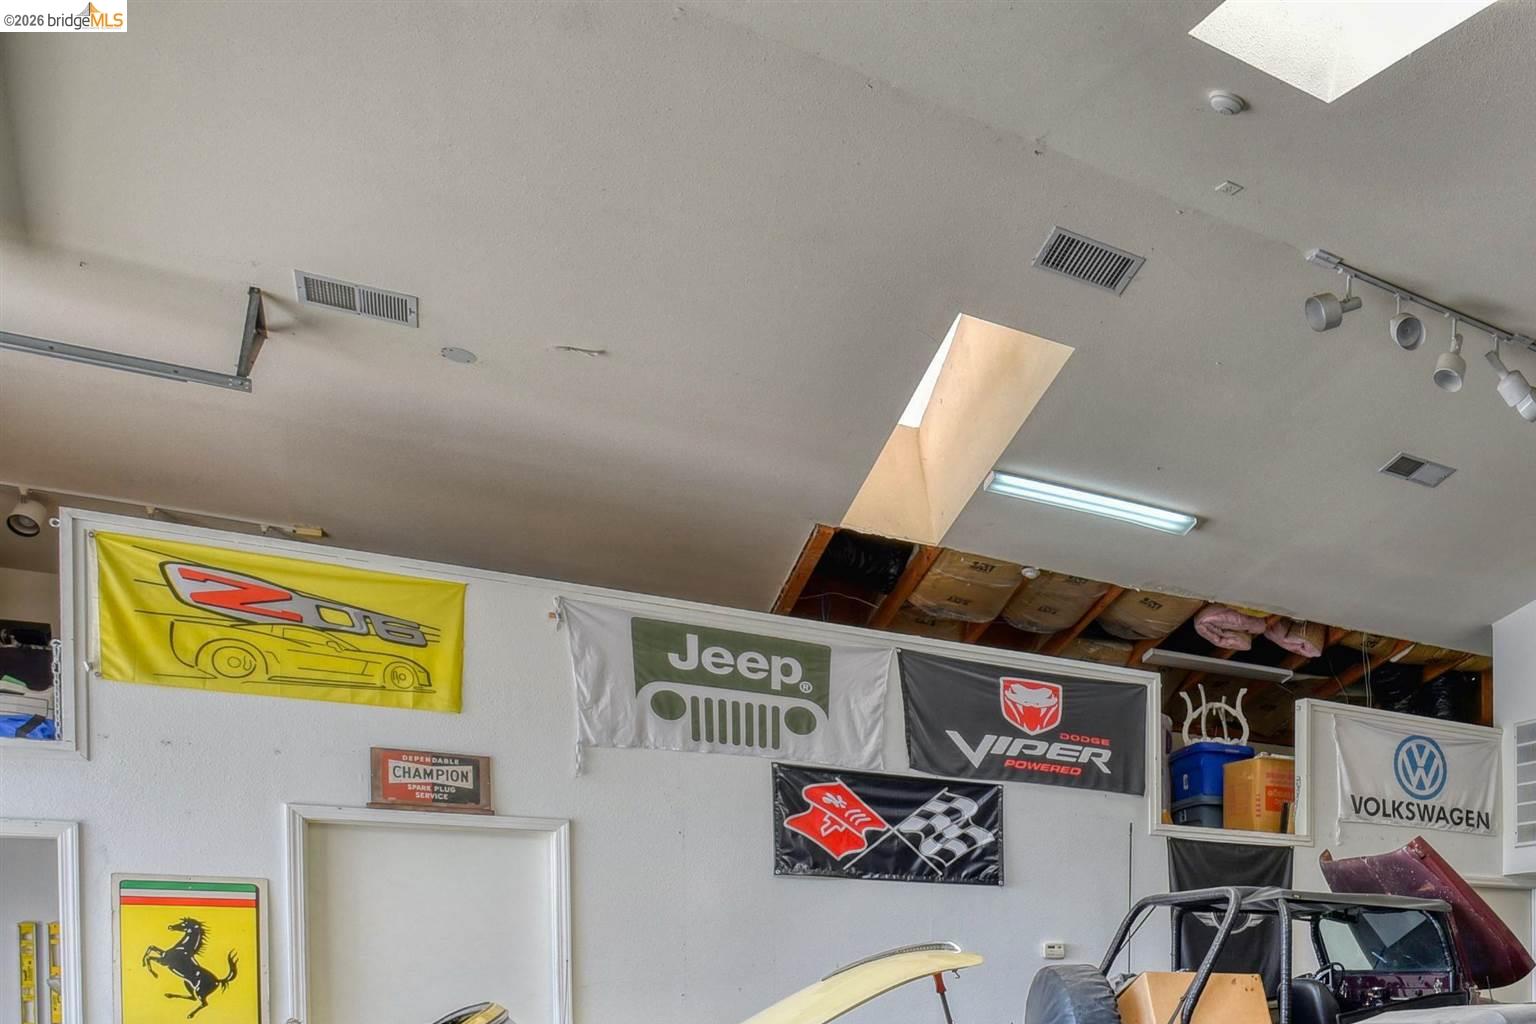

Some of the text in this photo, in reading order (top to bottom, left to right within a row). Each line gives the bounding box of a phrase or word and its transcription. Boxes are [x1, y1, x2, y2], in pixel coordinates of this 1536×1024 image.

[1059, 732, 1110, 746] DODGE
[402, 754, 460, 765] DEPENDABLE
[945, 729, 1112, 775] VIPER
[392, 765, 469, 783] CHAMPION
[1004, 759, 1082, 776] POWERED
[407, 783, 456, 793] SPARK PLUG
[415, 791, 448, 800] SERVICE
[1350, 794, 1490, 829] VOLKSWAGEN
